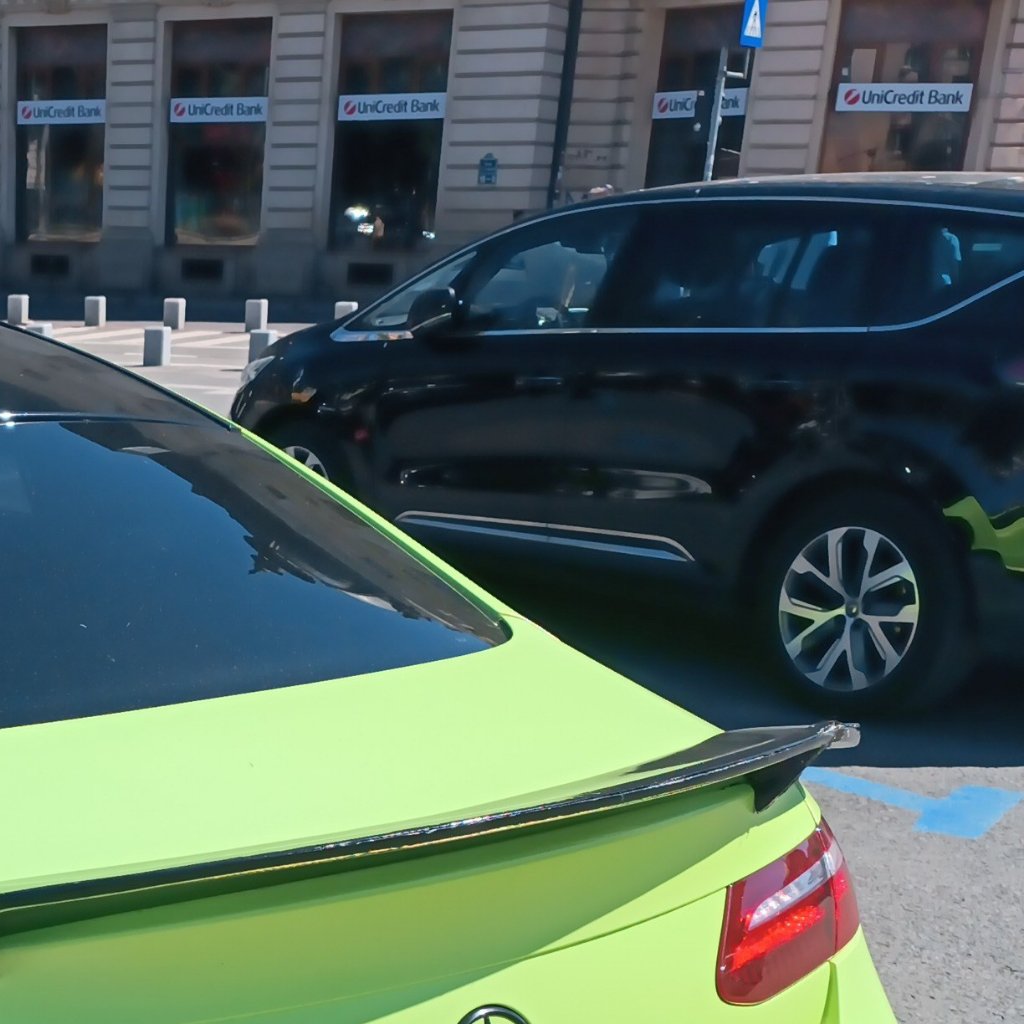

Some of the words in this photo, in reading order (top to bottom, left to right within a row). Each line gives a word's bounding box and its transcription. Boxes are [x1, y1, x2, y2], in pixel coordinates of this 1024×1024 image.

[862, 89, 924, 105] UniCredit
[928, 89, 964, 105] Bank
[33, 105, 75, 119] UniCredit
[77, 104, 102, 118] Bank
[188, 102, 234, 116] UniCredit
[236, 102, 263, 116] Bank
[357, 99, 408, 114] UniCredit
[411, 98, 440, 113] Bank
